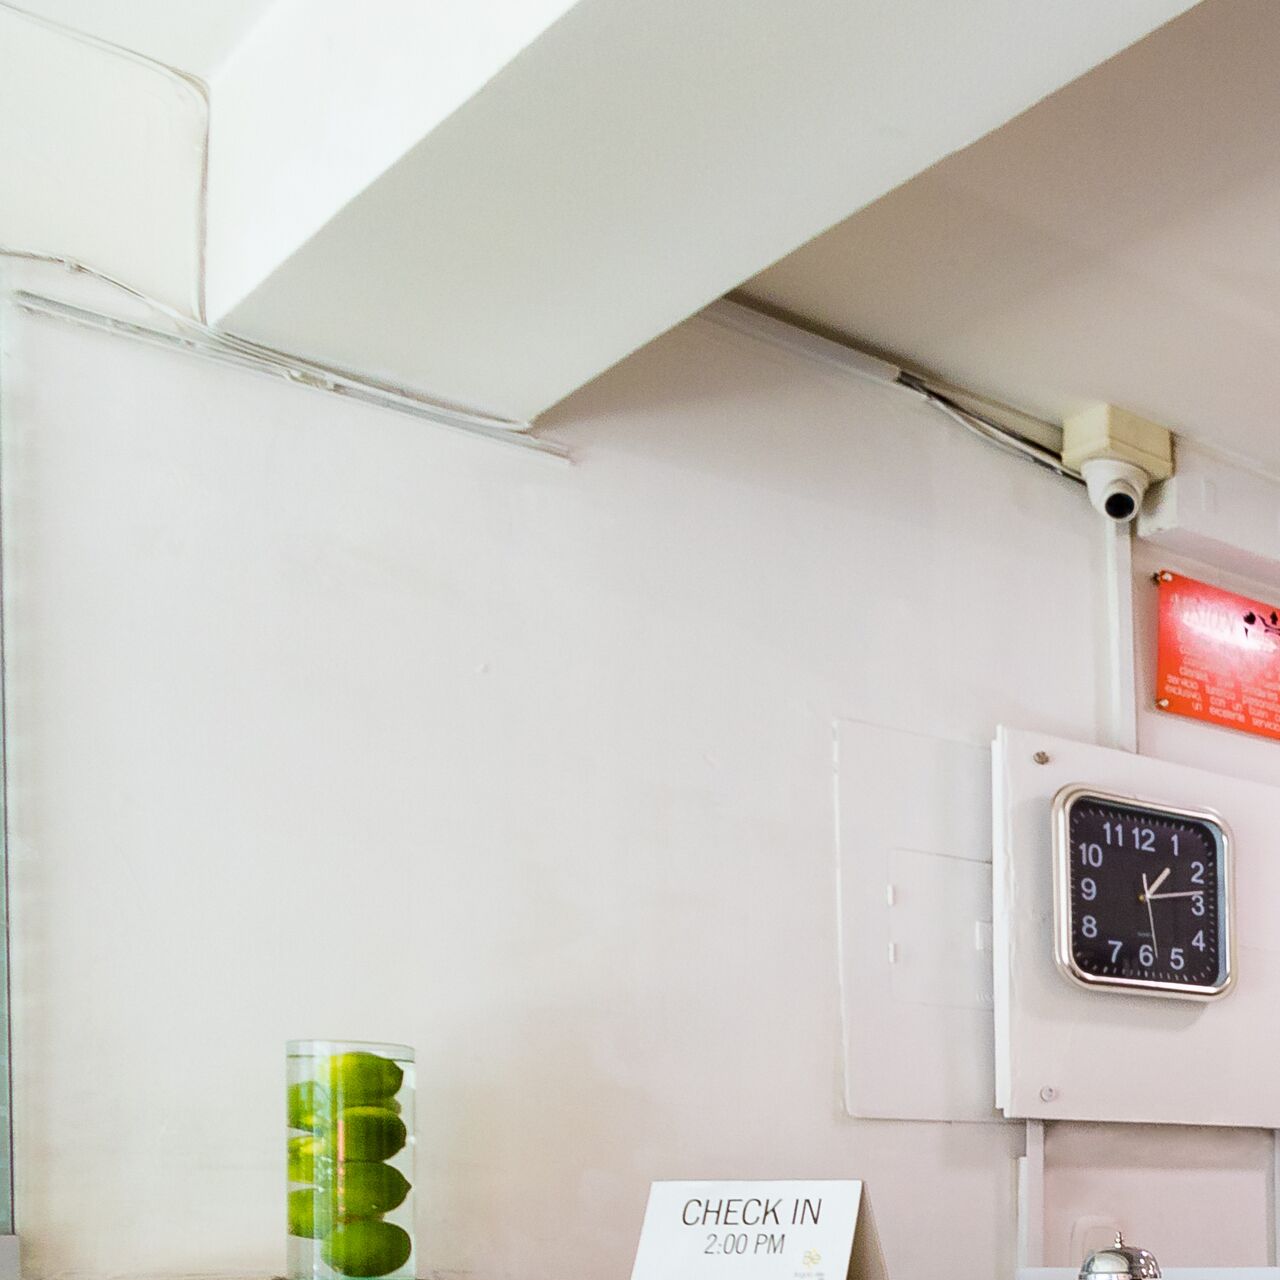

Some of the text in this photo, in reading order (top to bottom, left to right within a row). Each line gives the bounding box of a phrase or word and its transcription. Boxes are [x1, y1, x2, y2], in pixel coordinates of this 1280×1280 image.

[1103, 822, 1123, 847] 11
[1132, 827, 1155, 852] 12
[1171, 834, 1179, 856] 1
[1079, 843, 1103, 867] 10
[1190, 862, 1204, 884] 2
[1081, 878, 1097, 900] 9
[1191, 893, 1205, 916] 3
[1082, 915, 1098, 938] 8
[1107, 940, 1123, 963] 7
[1191, 930, 1206, 952] 4
[1139, 944, 1154, 967] 6
[1169, 948, 1185, 970] 5
[682, 1198, 822, 1226] CHECK IN
[703, 1233, 786, 1255] 2:00 PM
